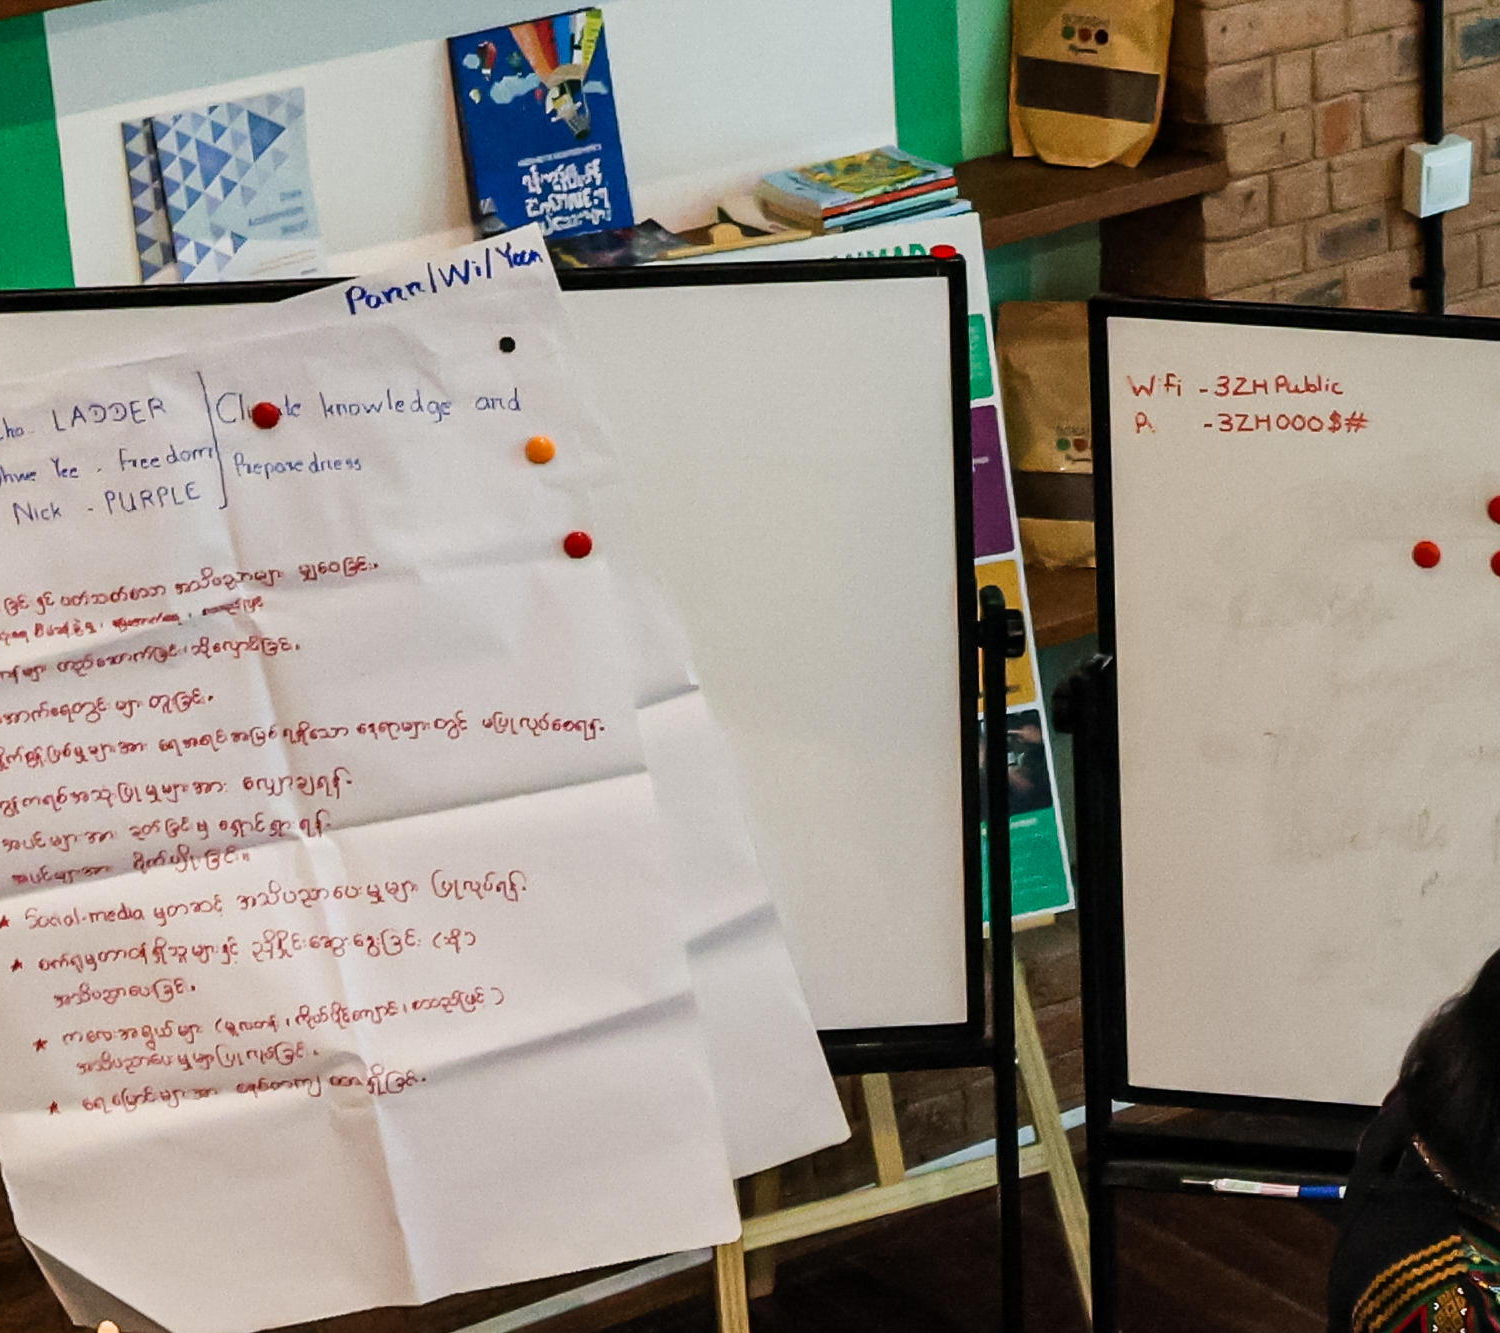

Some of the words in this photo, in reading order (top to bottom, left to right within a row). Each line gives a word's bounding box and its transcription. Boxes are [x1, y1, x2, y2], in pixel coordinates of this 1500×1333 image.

[50, 396, 167, 433] LADDER
[318, 381, 454, 424] knowledge
[473, 386, 522, 413] and
[11, 501, 63, 526] Nick
[102, 480, 201, 516] PURPLE
